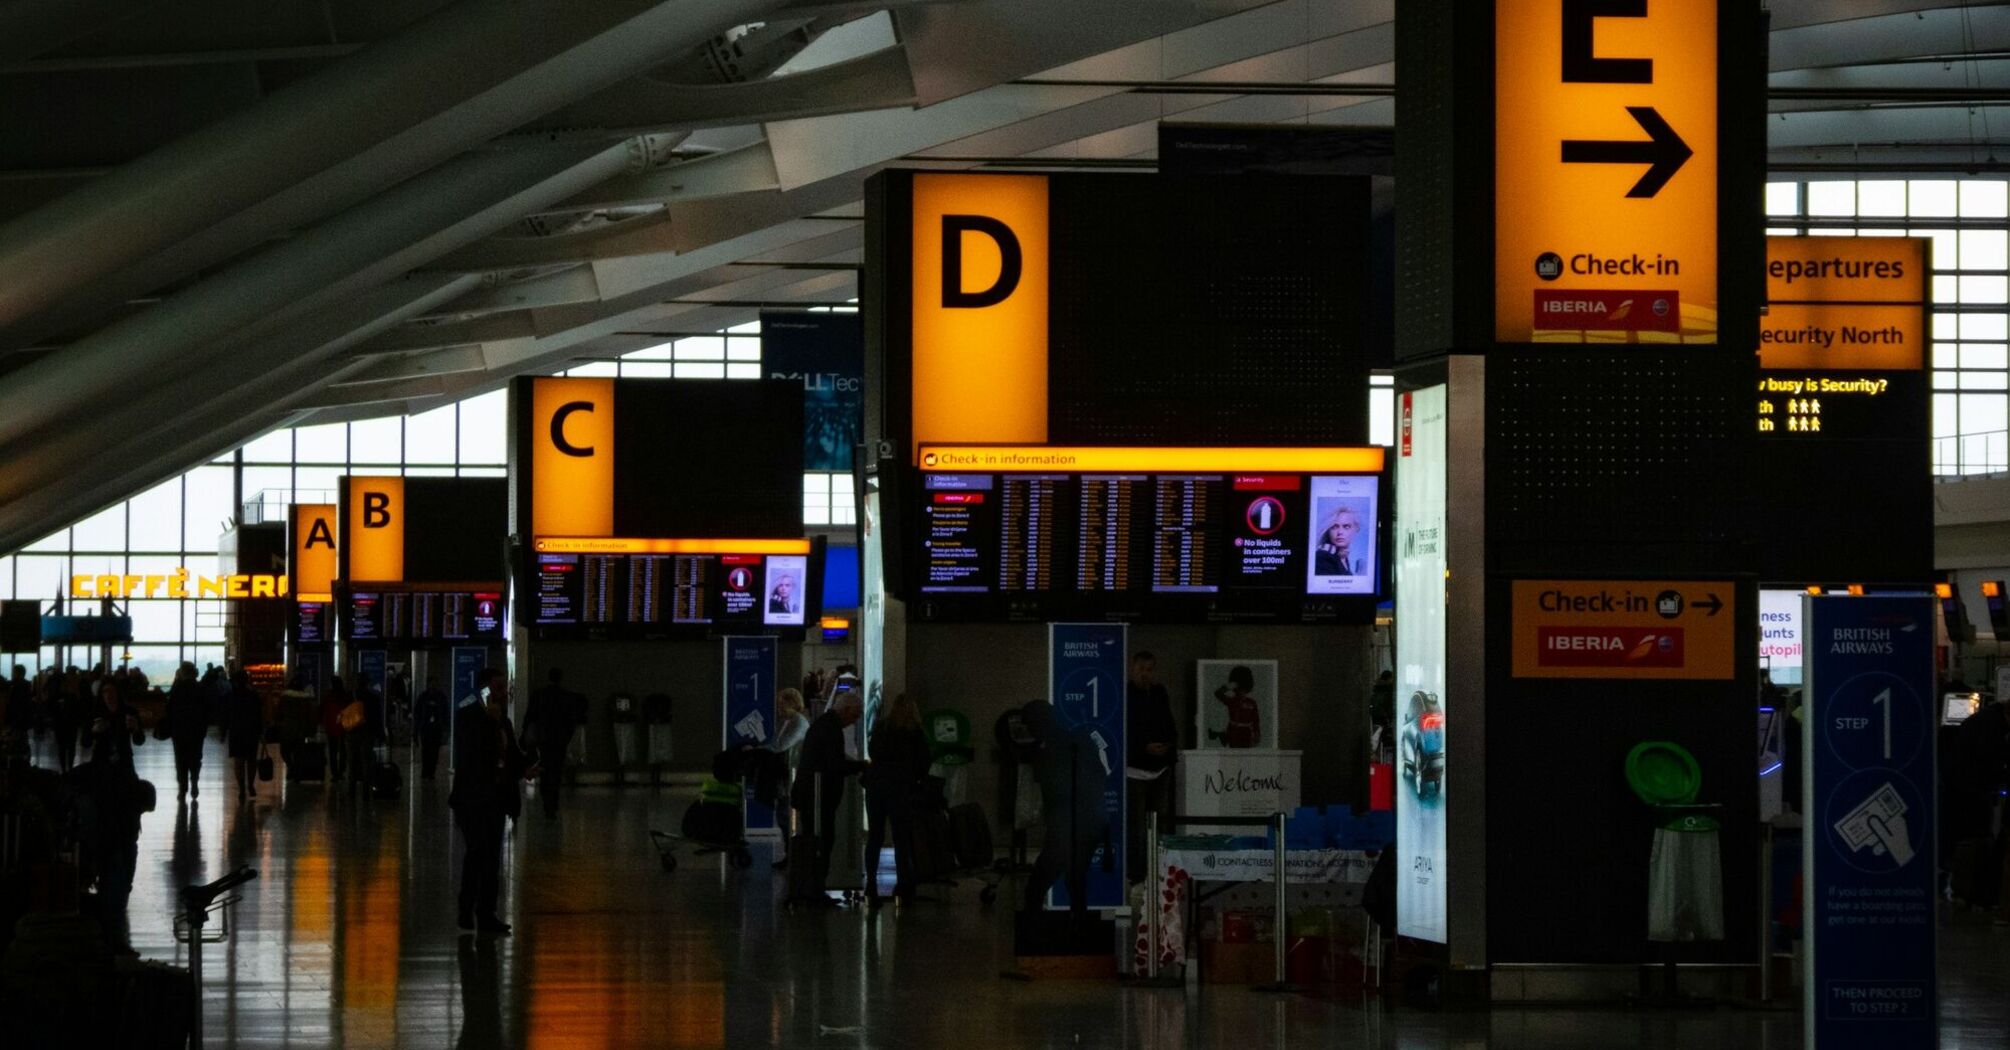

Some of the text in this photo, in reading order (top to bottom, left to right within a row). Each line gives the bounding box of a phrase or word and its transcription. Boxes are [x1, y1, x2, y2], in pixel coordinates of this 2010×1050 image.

[942, 214, 1022, 309] D
[1571, 254, 1680, 276] Check-in
[1769, 257, 1904, 283] epartures
[1542, 300, 1608, 314] IBERIA
[1761, 325, 1904, 348] ecurity North
[1768, 377, 1803, 395] busy
[1806, 377, 1818, 391] is
[1820, 378, 1888, 395] Security?
[550, 401, 595, 457] C
[941, 453, 1076, 465] Check-in information
[363, 492, 391, 528] B
[305, 518, 335, 549] A
[1244, 539, 1282, 548] No liquids
[1243, 547, 1292, 556] in containers
[1262, 556, 1285, 565] 100ml
[1539, 590, 1648, 612] Check-in
[1761, 612, 1792, 622] ness
[1833, 627, 1891, 641] BRITISH
[1064, 641, 1098, 650] BRITISH
[1547, 636, 1625, 651] IBERIA
[1830, 641, 1894, 655] AIRWAYS
[1063, 650, 1100, 658] AIRWAYS
[750, 672, 759, 702] 1
[1065, 692, 1085, 701] STEP
[1086, 675, 1098, 719] 1
[1835, 717, 1870, 730] STEP
[1872, 686, 1892, 760] 1
[1205, 769, 1284, 794] Welcome
[1217, 857, 1274, 867] CONTACTLESS
[1832, 987, 1922, 999] THEN PROCEED
[1850, 1002, 1909, 1014] TO STEP 2
